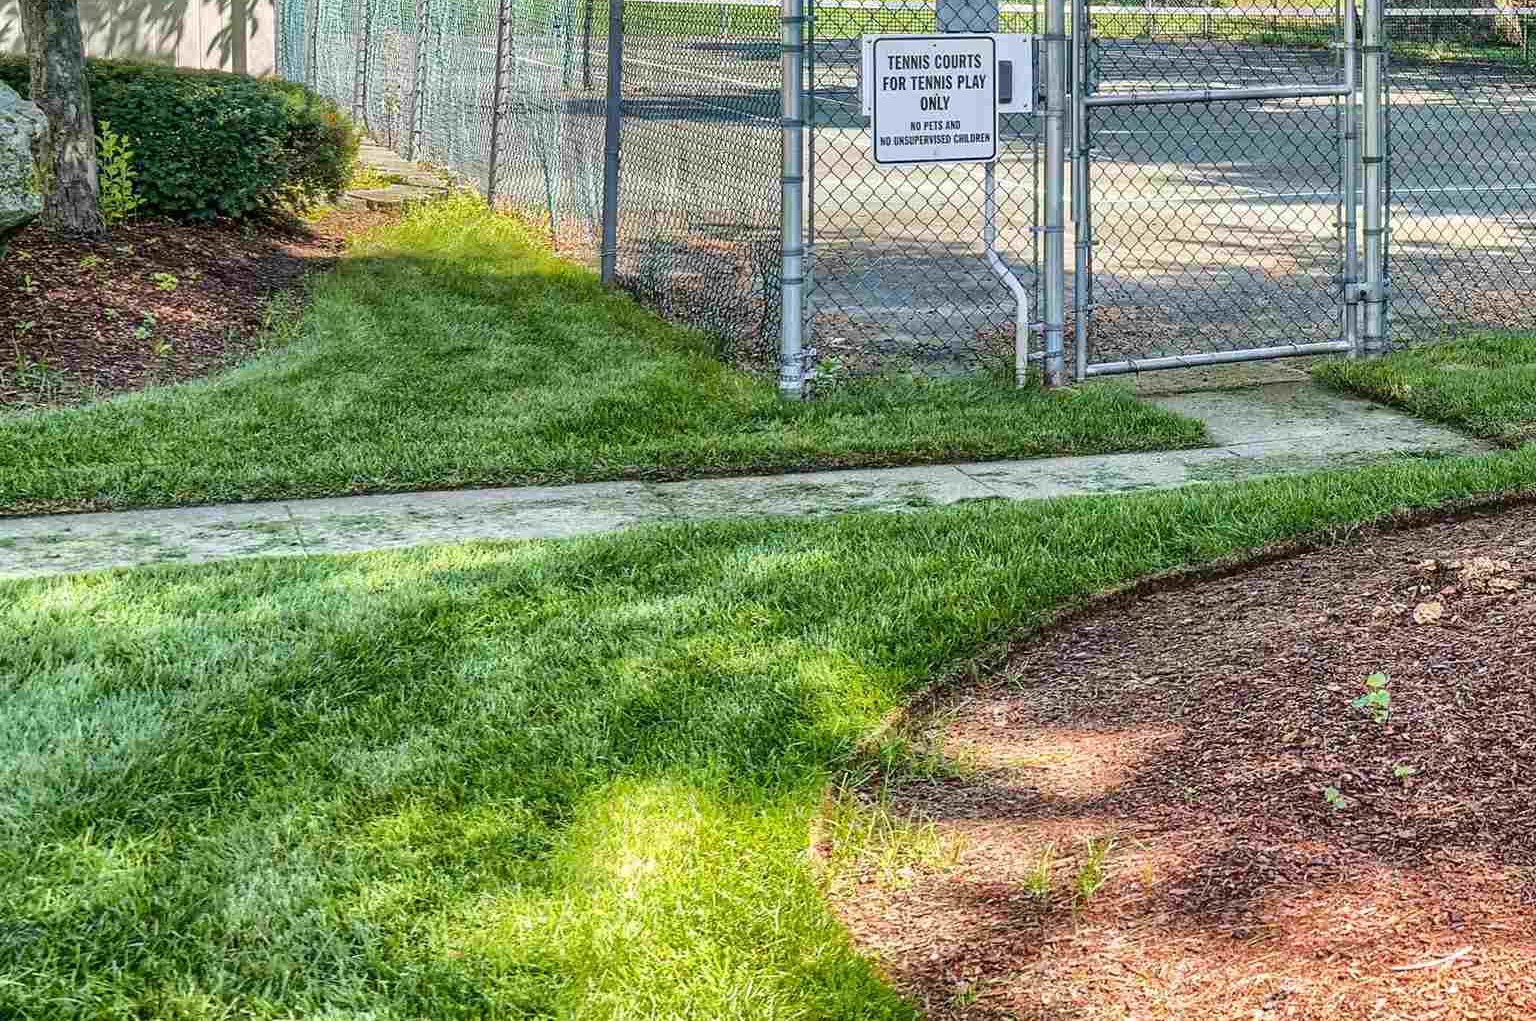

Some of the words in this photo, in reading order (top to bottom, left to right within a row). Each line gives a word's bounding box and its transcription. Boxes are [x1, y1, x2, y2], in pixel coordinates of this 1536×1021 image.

[888, 54, 930, 70] TENNIS
[934, 53, 982, 69] COURTS
[883, 76, 906, 91] FOR
[911, 75, 953, 90] TENNIS
[957, 74, 986, 90] PLAY
[920, 96, 950, 111] ONLY
[910, 121, 921, 131] NO
[923, 121, 943, 131] PETS
[945, 120, 961, 130] AND
[880, 136, 891, 146] NO
[894, 134, 951, 146] UNSUPERVISED
[953, 133, 991, 144] CHILDREN
